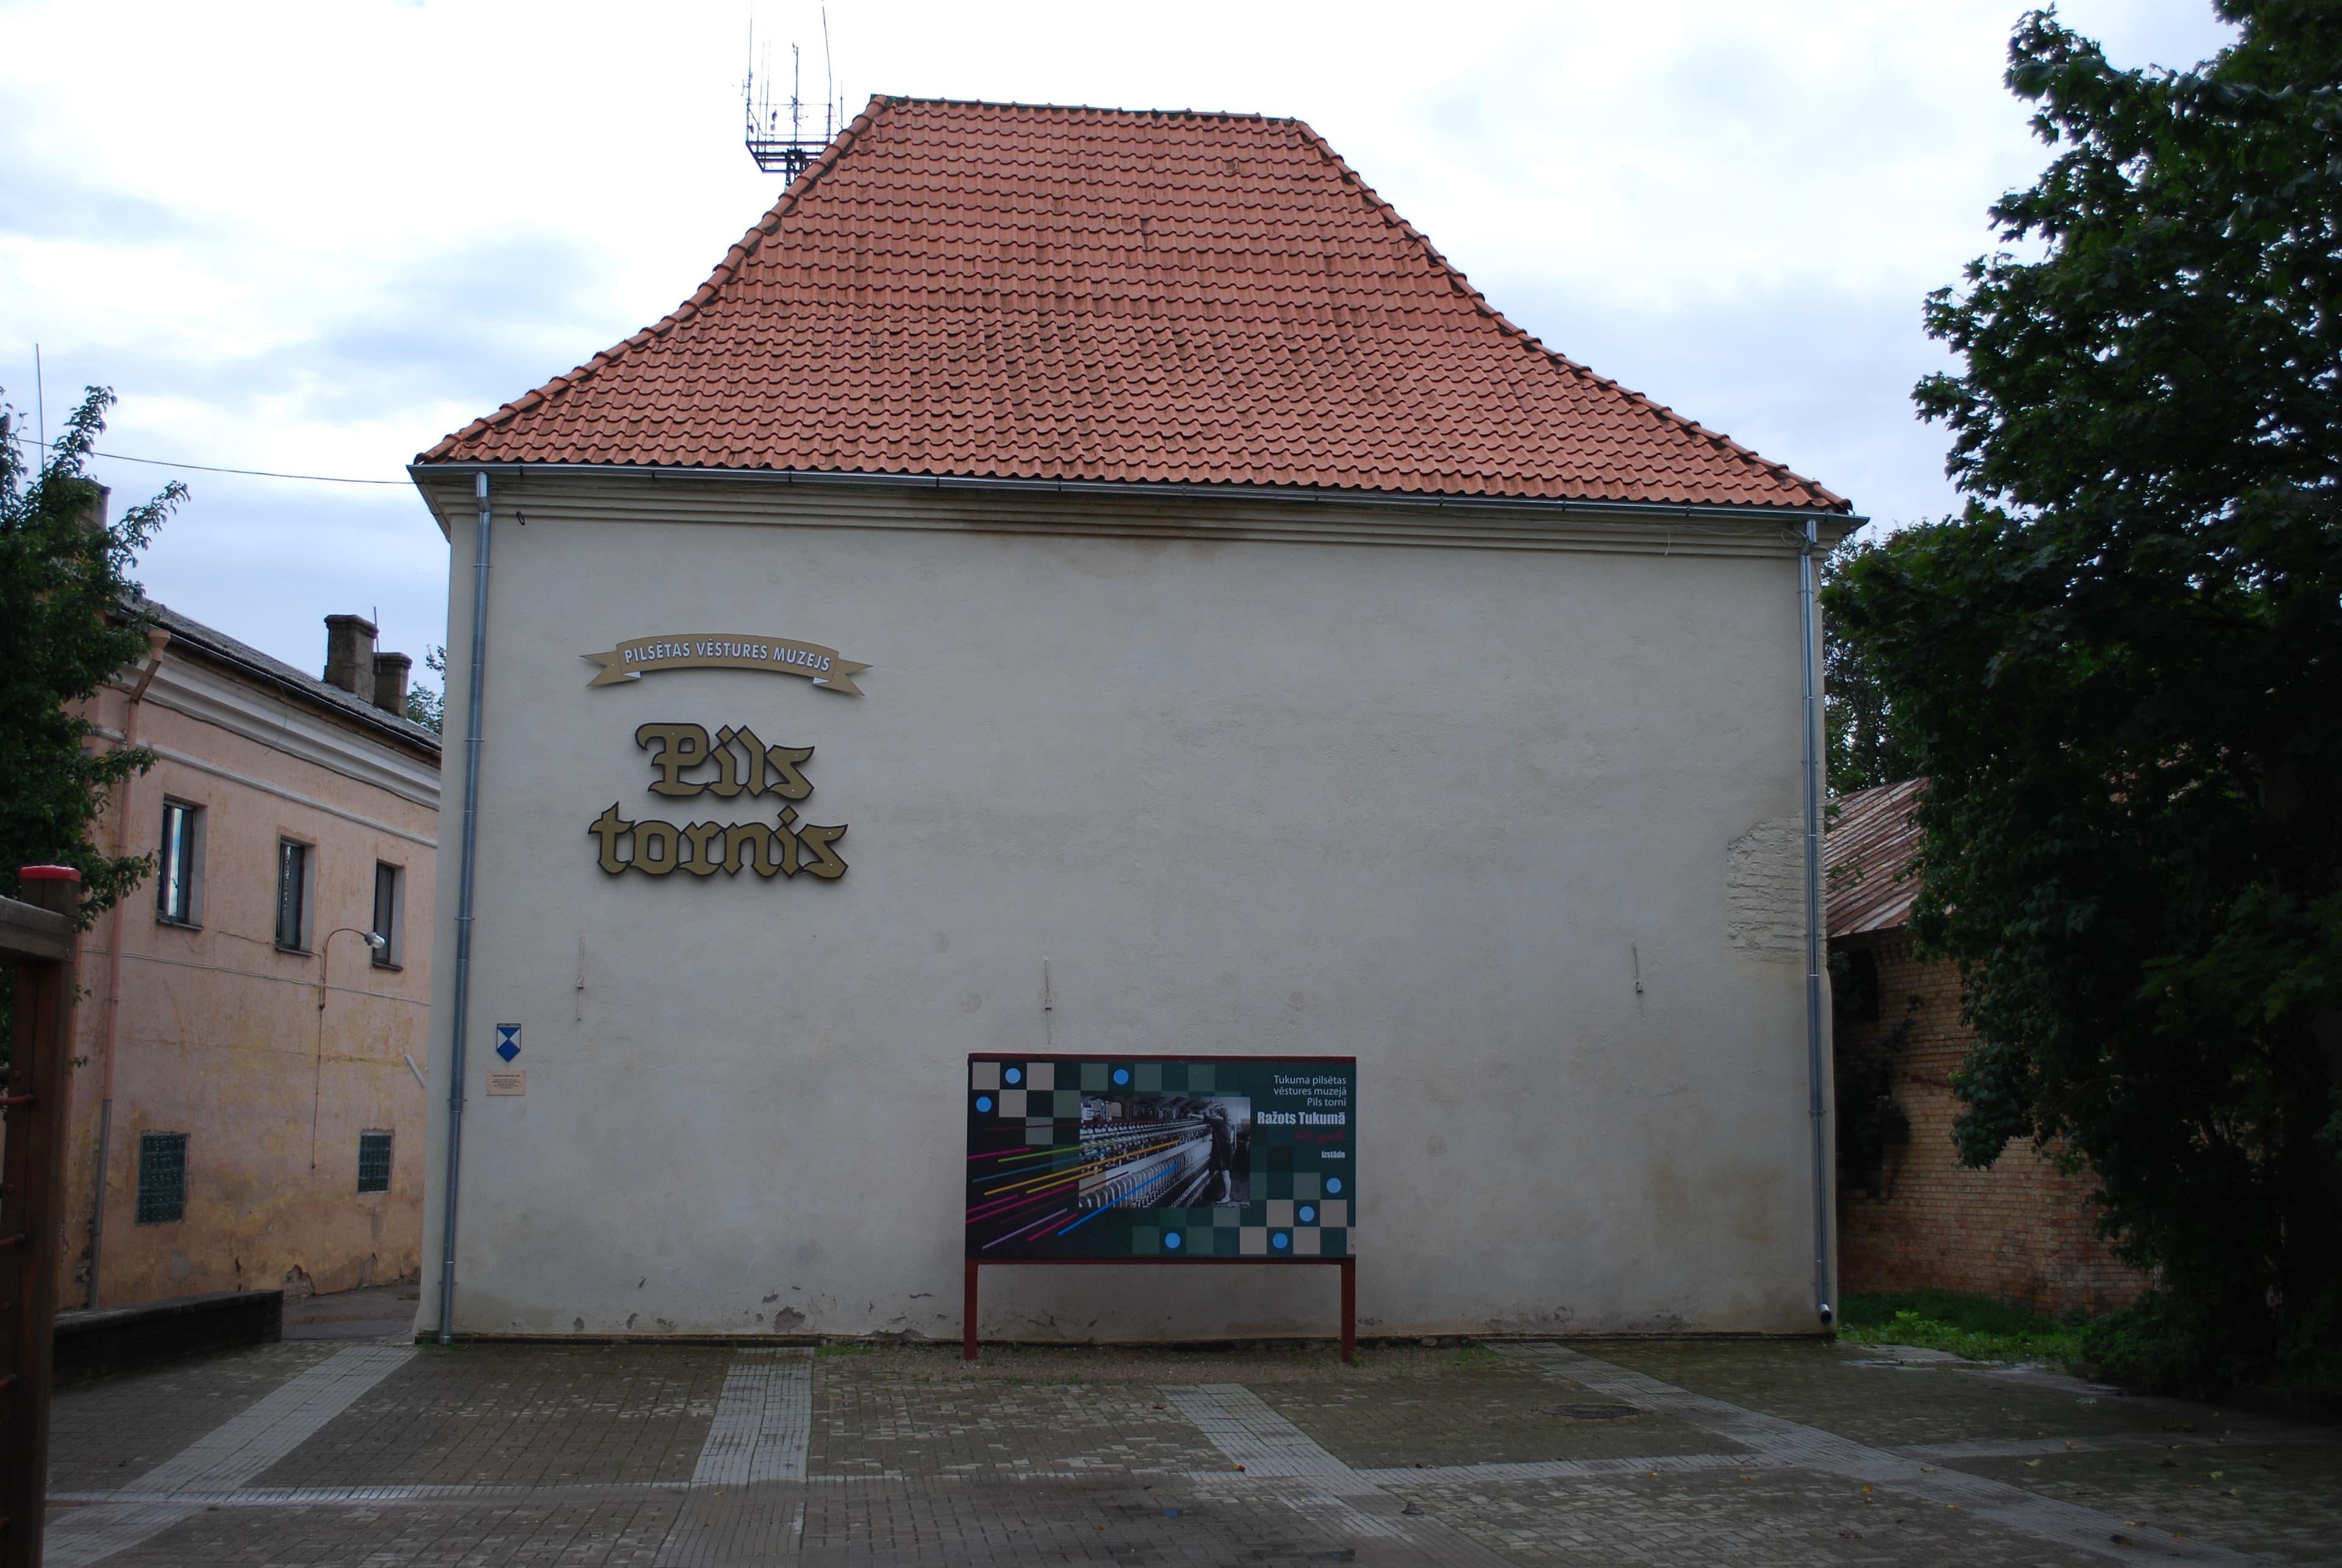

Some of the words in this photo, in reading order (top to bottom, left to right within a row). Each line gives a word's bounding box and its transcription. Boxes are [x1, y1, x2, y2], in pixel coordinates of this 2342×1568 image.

[624, 640, 690, 664] PILSĒTAS
[696, 639, 768, 659] VĒSTURES
[773, 646, 831, 671] MUZEJS
[635, 722, 815, 800] Pils
[587, 801, 849, 879] tornis
[1273, 1075, 1310, 1084] Tukuma
[1312, 1075, 1347, 1086] pilsētas
[1273, 1087, 1311, 1095] vēstures
[1314, 1087, 1347, 1097] muzejā
[1307, 1097, 1322, 1106] Pils
[1257, 1111, 1296, 1125] Ražots
[1298, 1112, 1345, 1125] Tukumā
